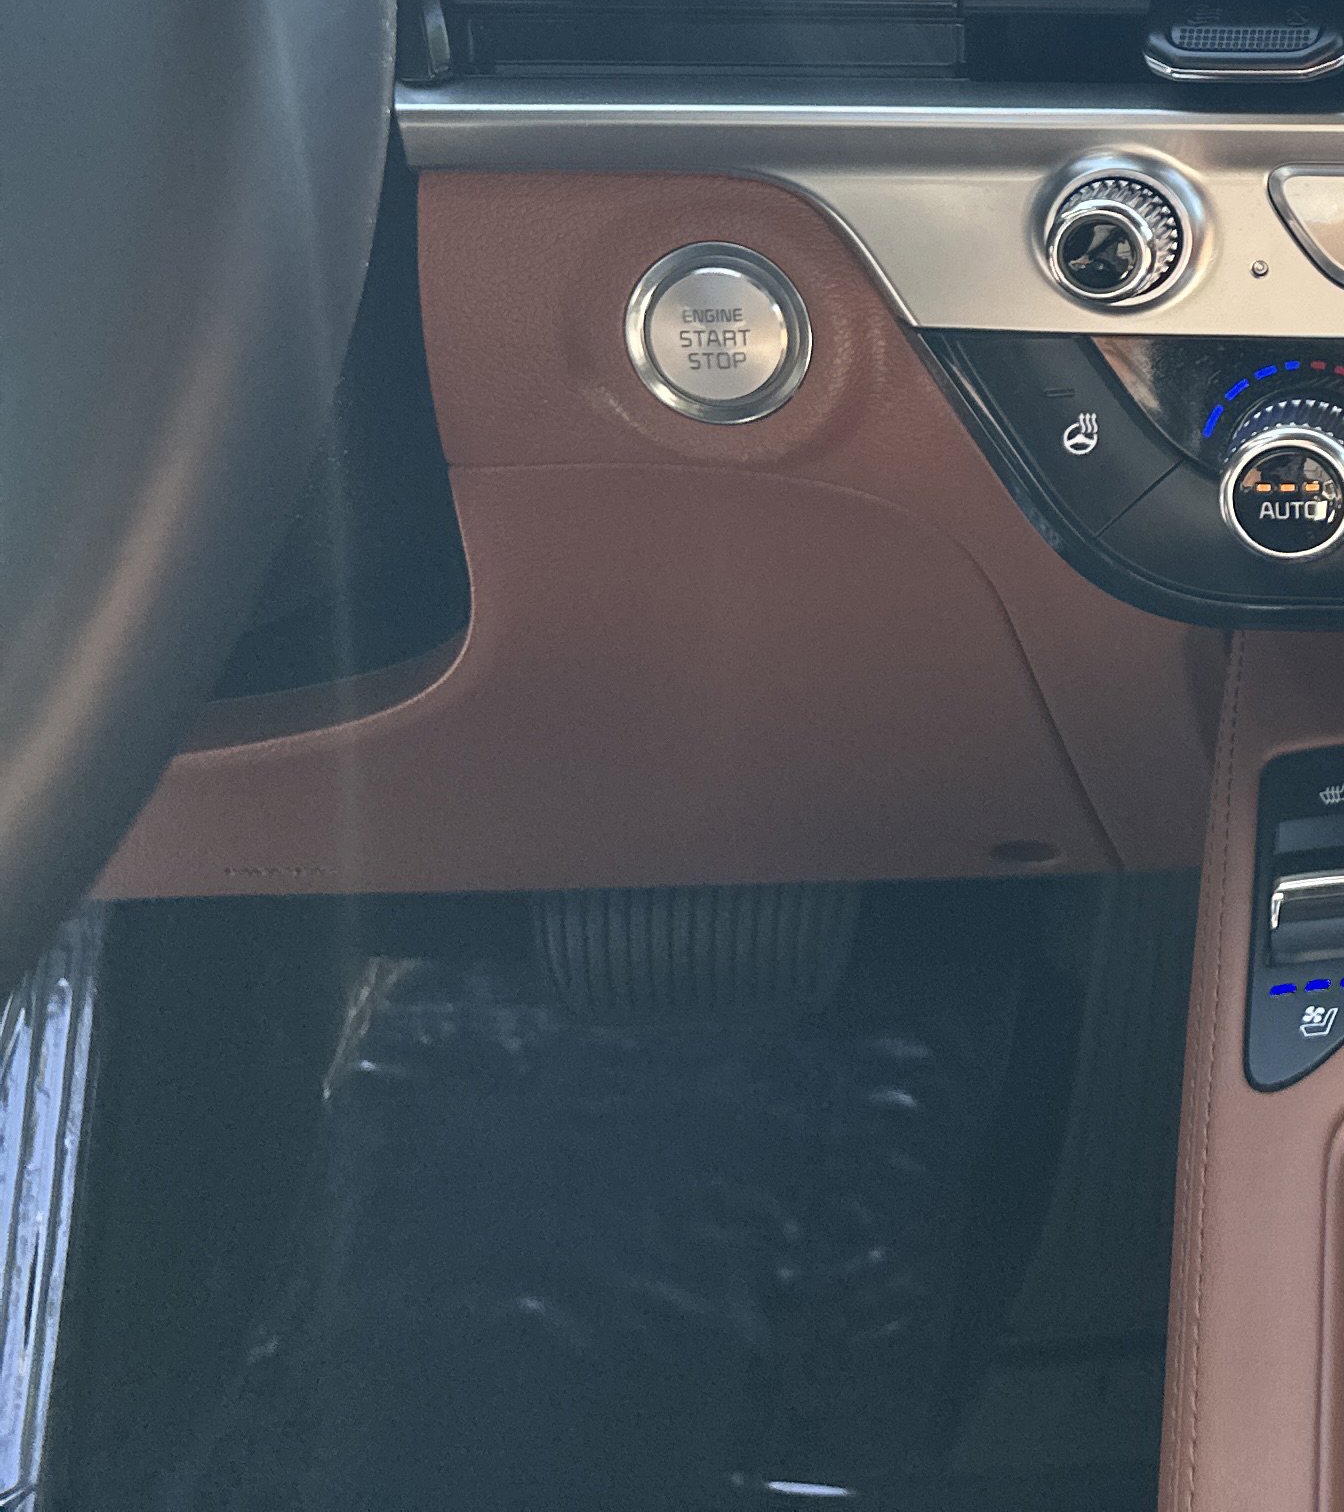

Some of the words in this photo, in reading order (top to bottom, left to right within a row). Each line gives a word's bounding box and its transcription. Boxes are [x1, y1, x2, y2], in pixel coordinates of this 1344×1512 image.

[682, 308, 744, 324] ENGINE
[679, 329, 751, 348] START
[687, 352, 747, 370] STOP
[1259, 501, 1319, 520] AUTO
